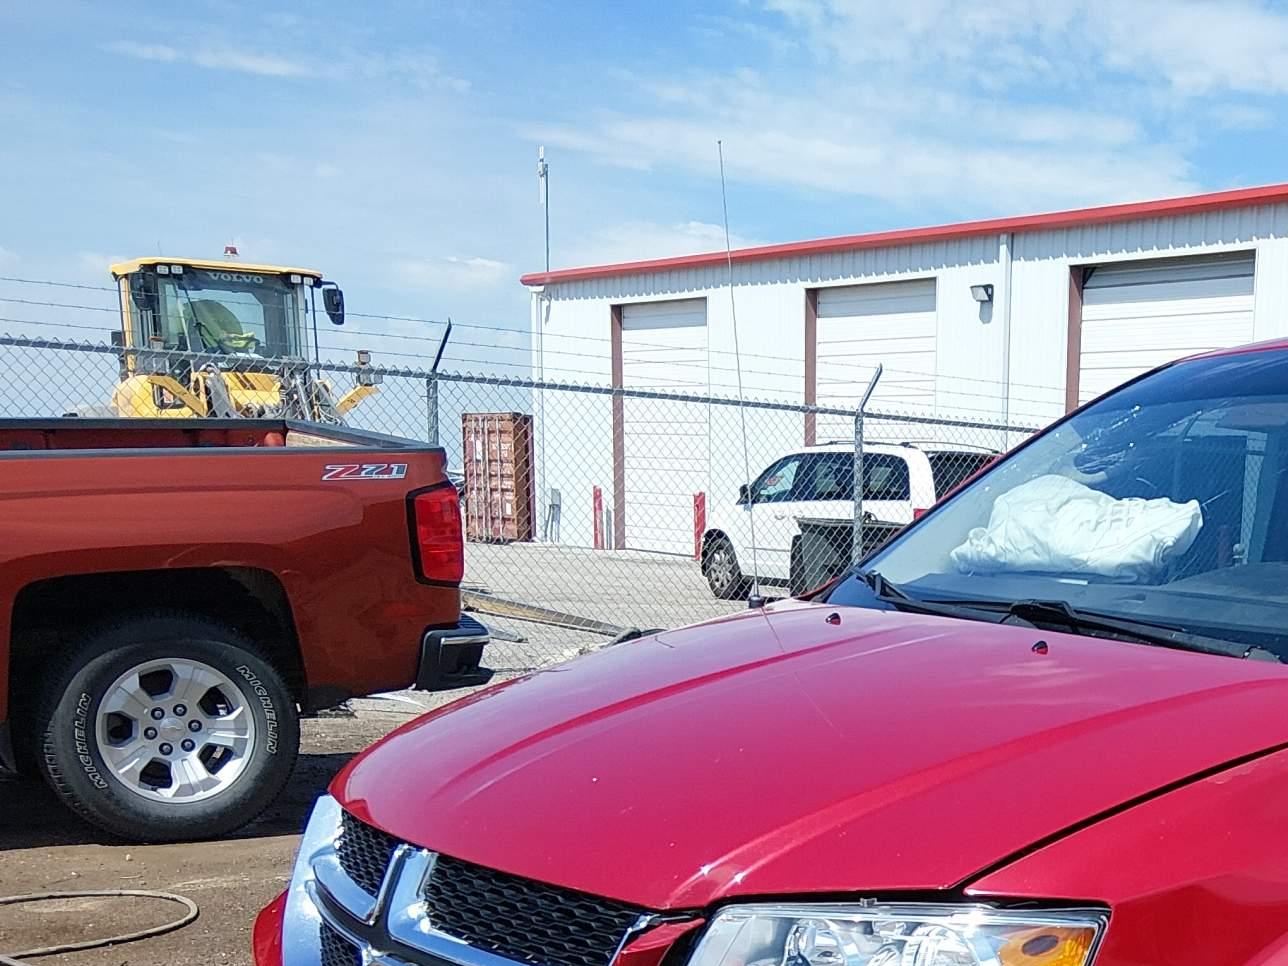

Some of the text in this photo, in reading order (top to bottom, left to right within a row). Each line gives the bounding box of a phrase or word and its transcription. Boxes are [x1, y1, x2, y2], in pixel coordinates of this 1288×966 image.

[207, 272, 264, 285] VOLVO
[321, 463, 409, 481] Z71
[236, 666, 280, 753] MICHELIN
[73, 694, 108, 788] MICHELIN
